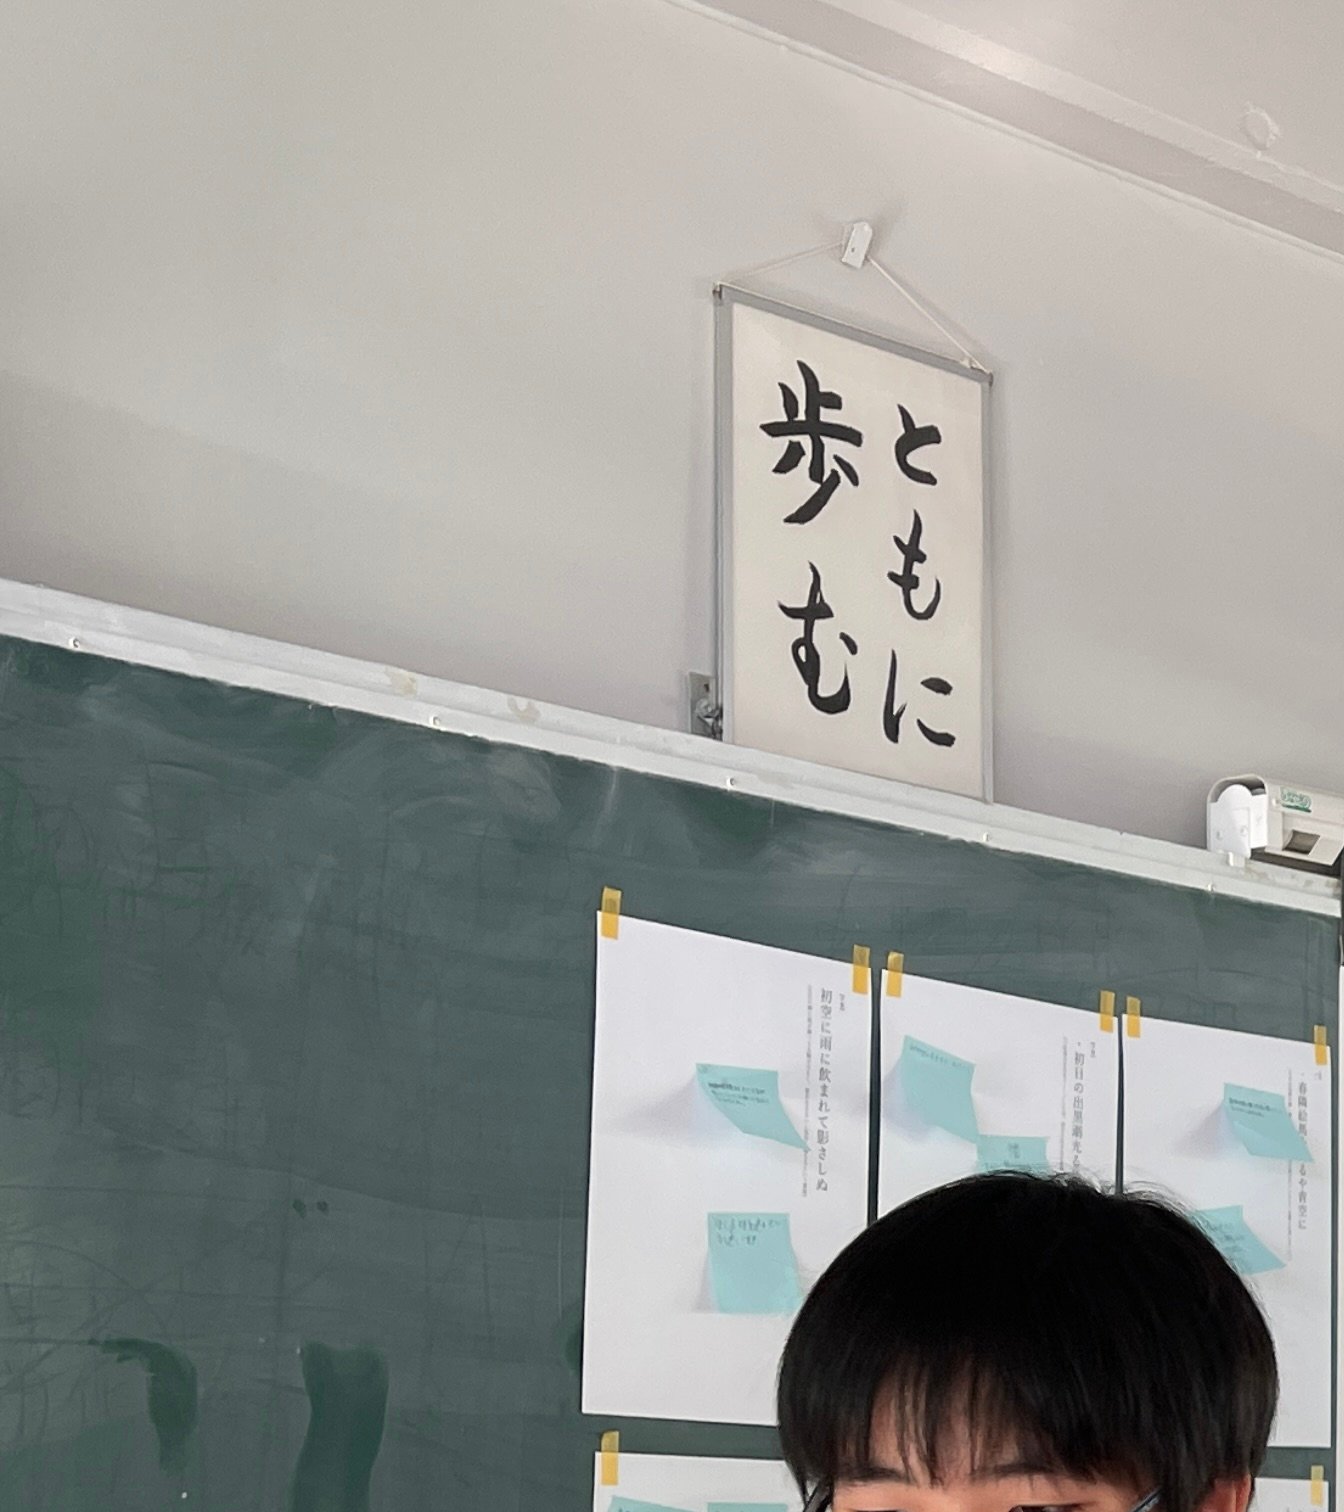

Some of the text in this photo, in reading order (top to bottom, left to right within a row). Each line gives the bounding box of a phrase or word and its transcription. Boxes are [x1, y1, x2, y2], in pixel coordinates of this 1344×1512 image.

[759, 359, 863, 715] 歩む
[883, 403, 957, 747] ともに
